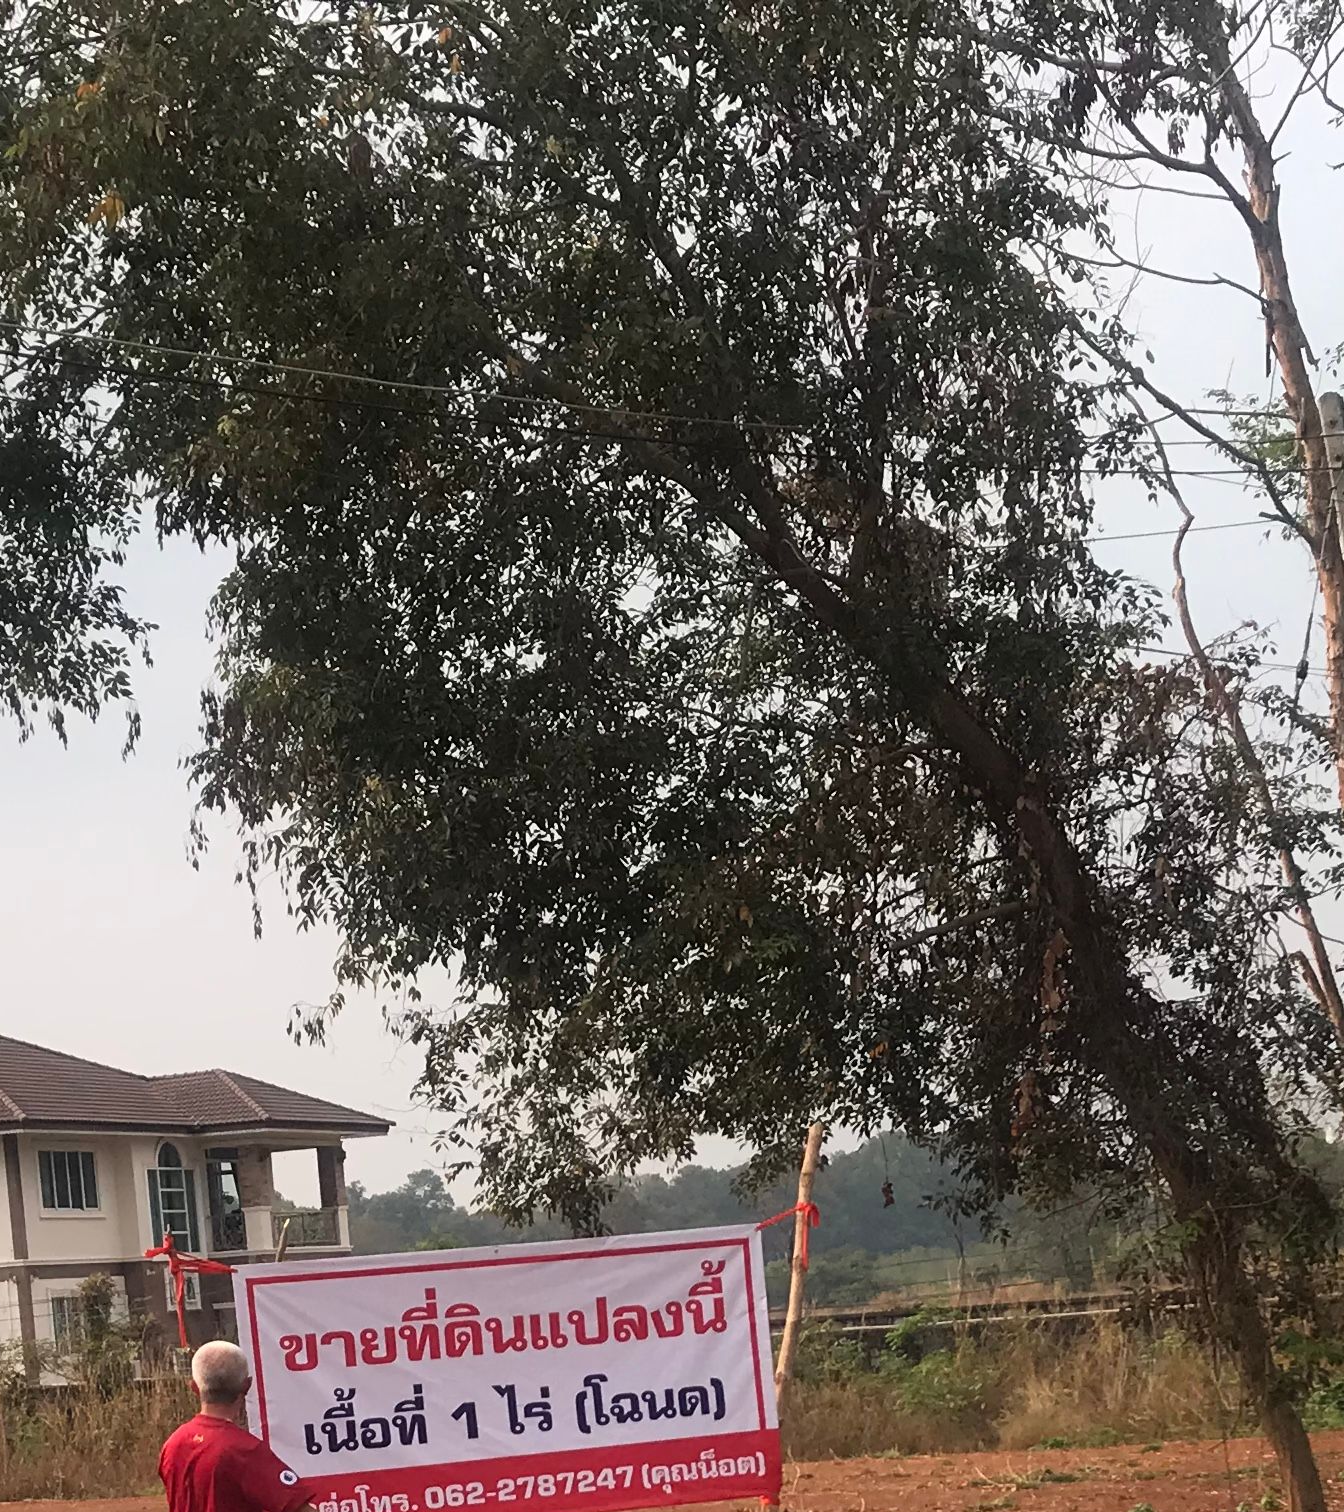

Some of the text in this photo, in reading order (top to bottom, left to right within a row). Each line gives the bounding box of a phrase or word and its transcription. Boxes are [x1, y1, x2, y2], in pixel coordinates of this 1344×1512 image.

[279, 1259, 728, 1372] ขายที่ดินแปลงนี้
[304, 1373, 727, 1455] เนื้อที่ 1 ไร่ (โฉนด)
[424, 1465, 634, 1510] 062-2787247
[641, 1448, 766, 1495] (คุณน็อต)
